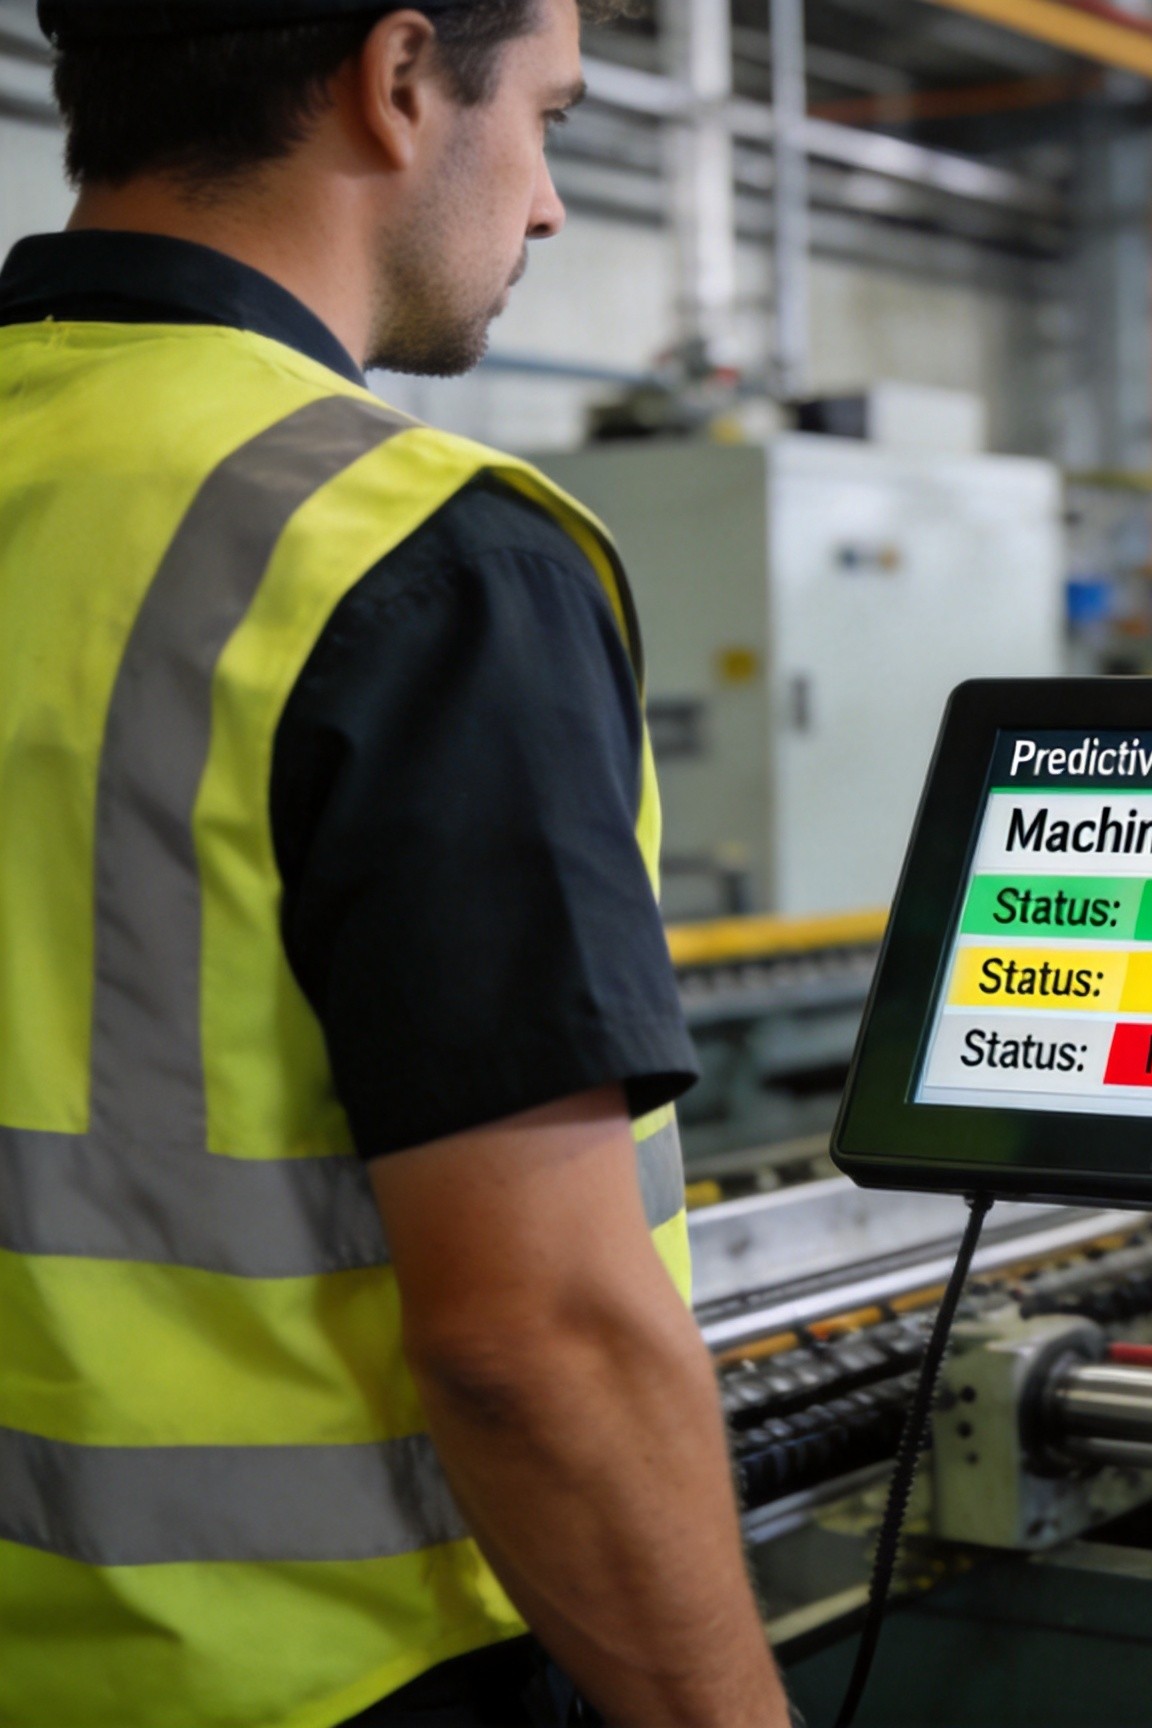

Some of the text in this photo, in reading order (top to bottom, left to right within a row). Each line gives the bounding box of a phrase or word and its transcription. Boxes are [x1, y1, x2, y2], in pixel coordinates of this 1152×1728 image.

[993, 886, 1121, 928] Status:
[979, 957, 1104, 998] Status:
[960, 1030, 1089, 1073] Status:
